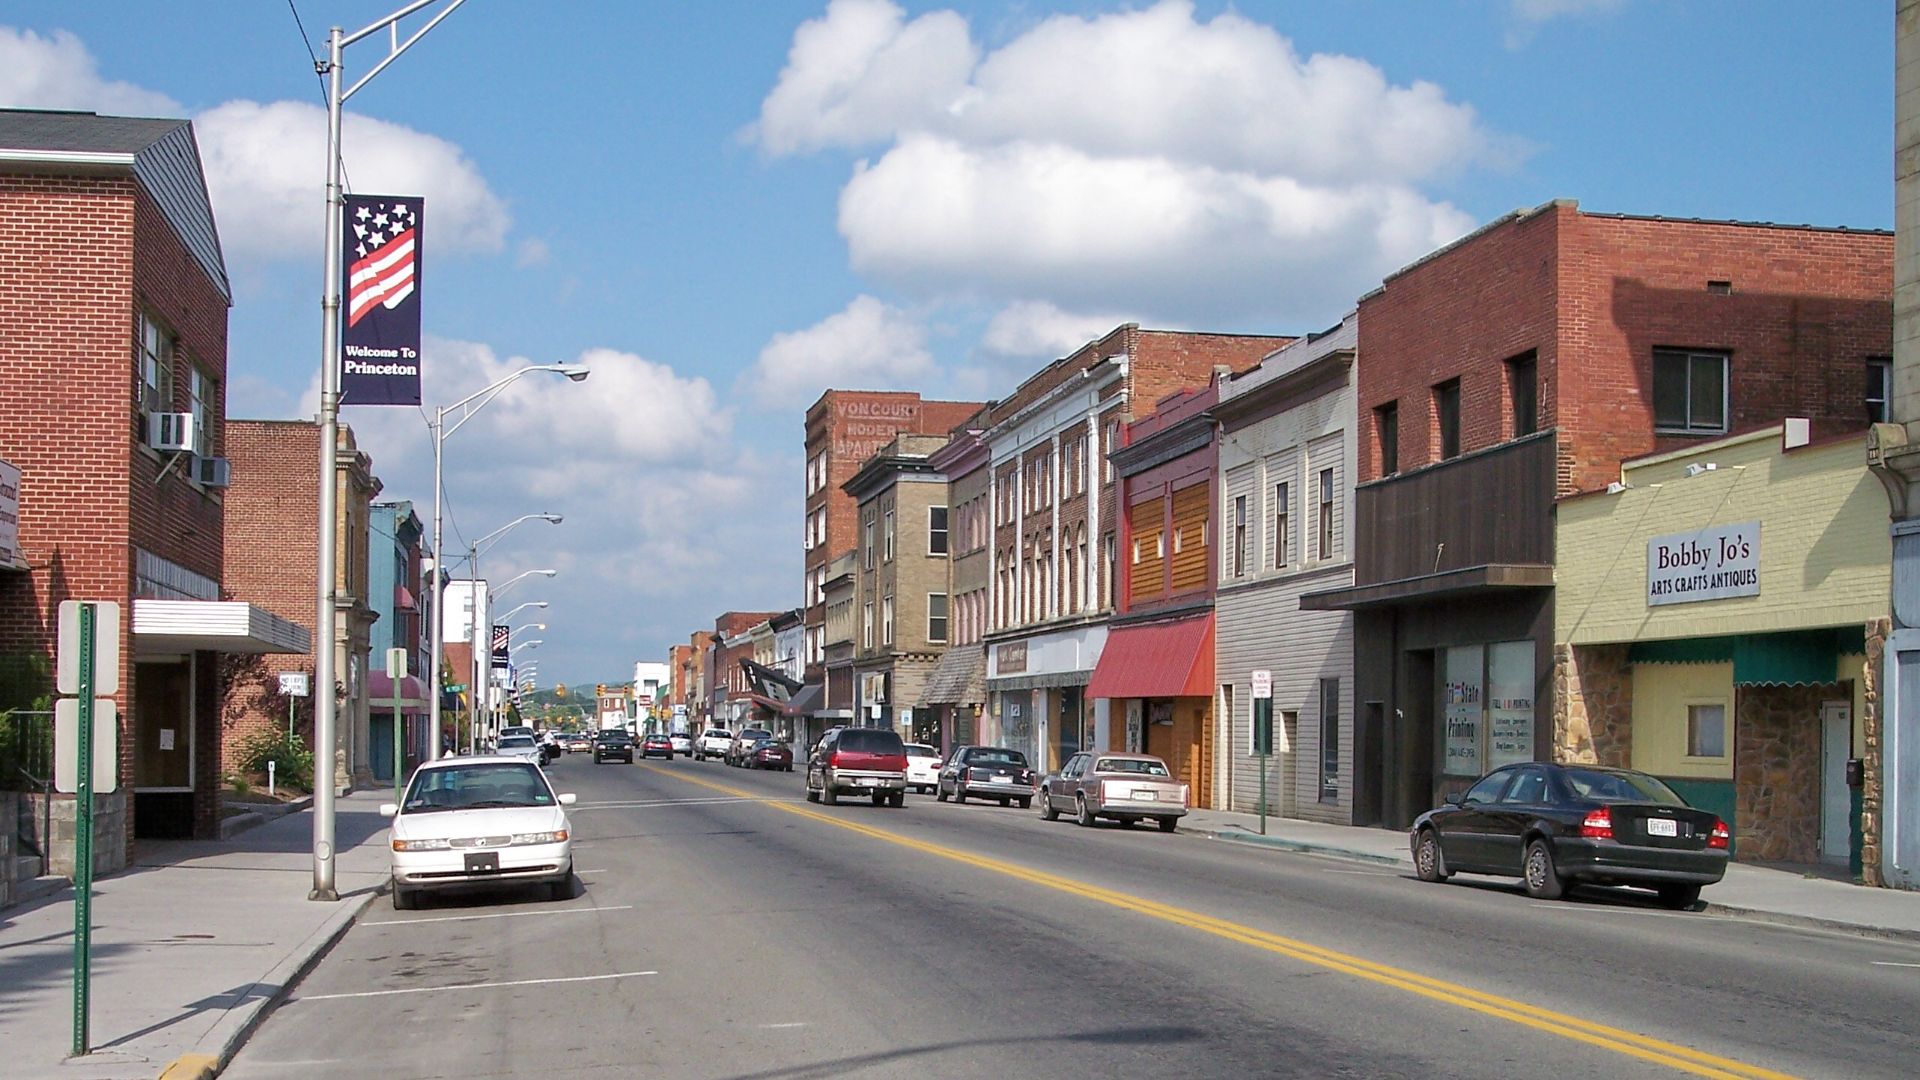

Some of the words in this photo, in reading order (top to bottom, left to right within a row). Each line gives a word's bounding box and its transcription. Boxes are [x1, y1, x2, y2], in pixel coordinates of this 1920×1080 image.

[345, 345, 399, 358] Welcome
[400, 347, 417, 359] To
[344, 360, 417, 376] Princeton
[1658, 540, 1711, 570] Bobby
[1717, 534, 1750, 568] Jo's
[1651, 579, 1672, 596] ARTS
[1675, 574, 1708, 593] CRAFTS
[1710, 569, 1757, 589] ANTIQUES
[1447, 717, 1475, 744] Printing
